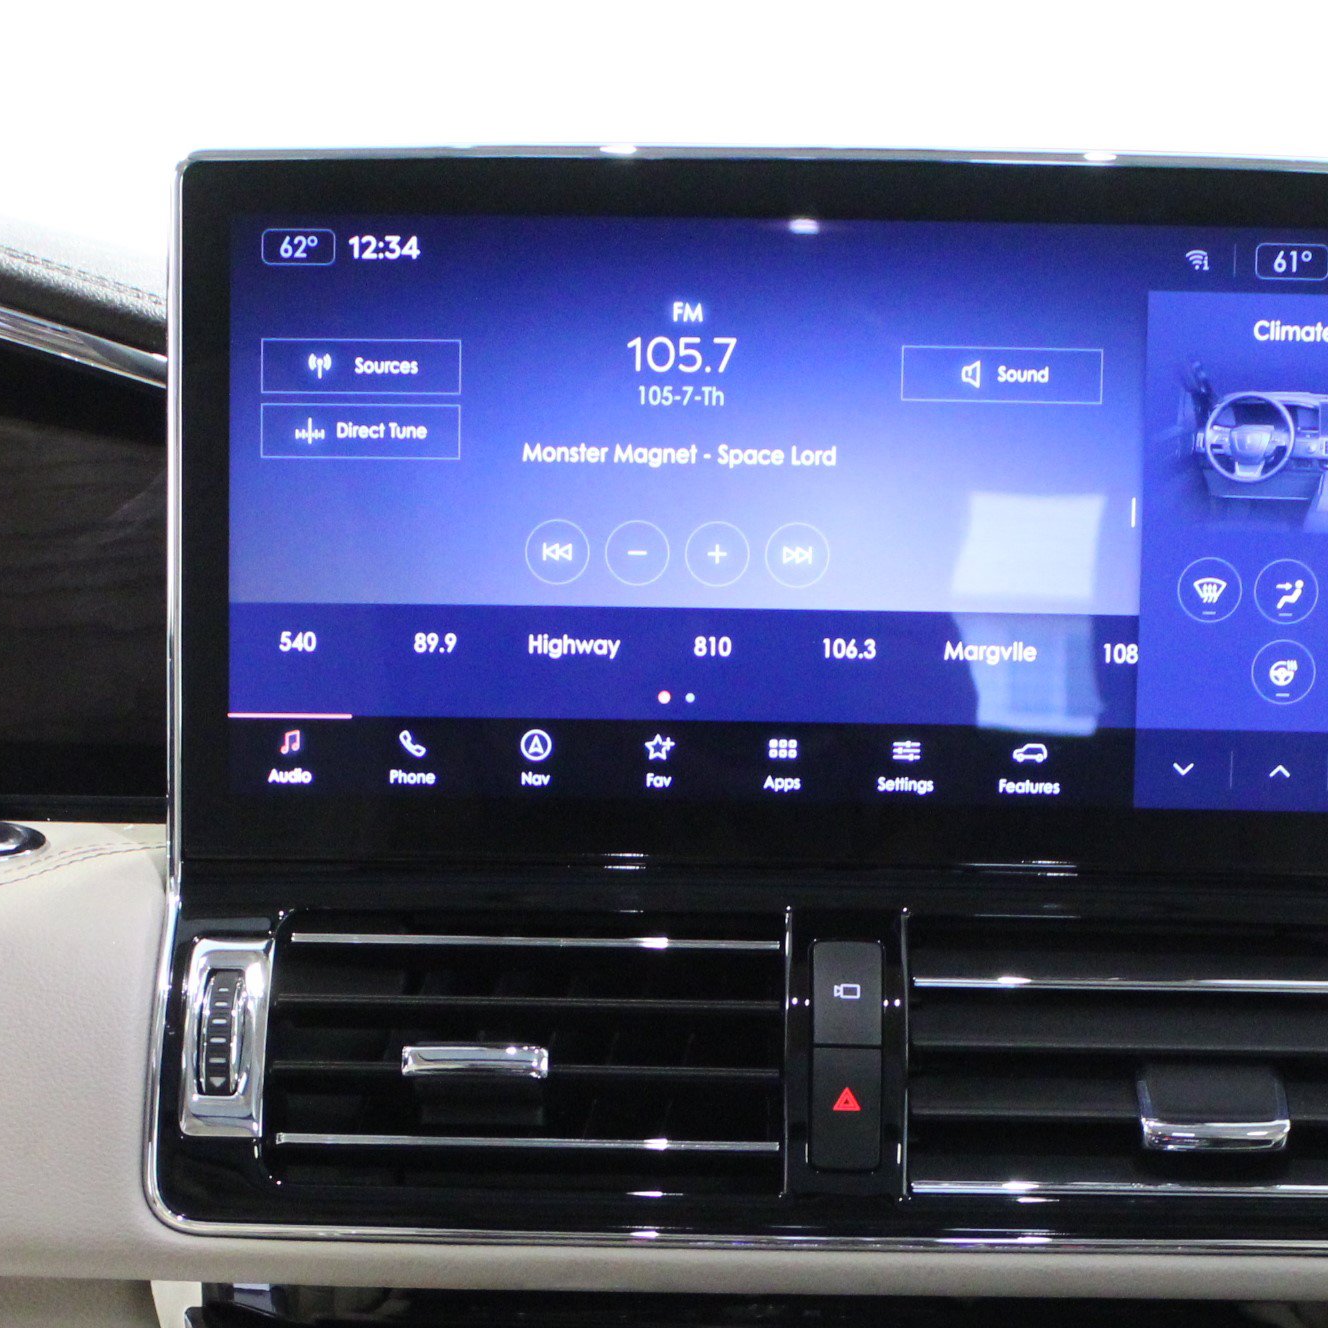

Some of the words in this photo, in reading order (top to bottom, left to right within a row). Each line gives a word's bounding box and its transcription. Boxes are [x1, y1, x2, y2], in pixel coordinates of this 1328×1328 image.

[348, 235, 421, 260] 12:34
[672, 303, 704, 322] FM
[627, 337, 738, 373] 105.7
[354, 357, 419, 375] Sources
[997, 365, 1050, 384] Sound
[638, 386, 725, 406] 105-7-Th
[336, 421, 385, 440] Direct
[389, 421, 428, 440] Tune
[522, 443, 608, 463] Monster
[614, 444, 698, 468] Magnet
[717, 445, 785, 468] Space
[791, 446, 837, 466] Lord
[279, 632, 317, 652] 540
[414, 633, 457, 654] 89.9
[528, 634, 621, 659] Highway
[694, 636, 732, 657] 810
[822, 638, 876, 659] 106.3
[268, 768, 312, 784] Audio
[389, 769, 436, 785] Phone
[521, 771, 550, 787] Nav
[646, 772, 672, 788] Fav
[764, 774, 801, 792] Apps
[877, 775, 934, 795] Settings
[998, 778, 1060, 796] Features
